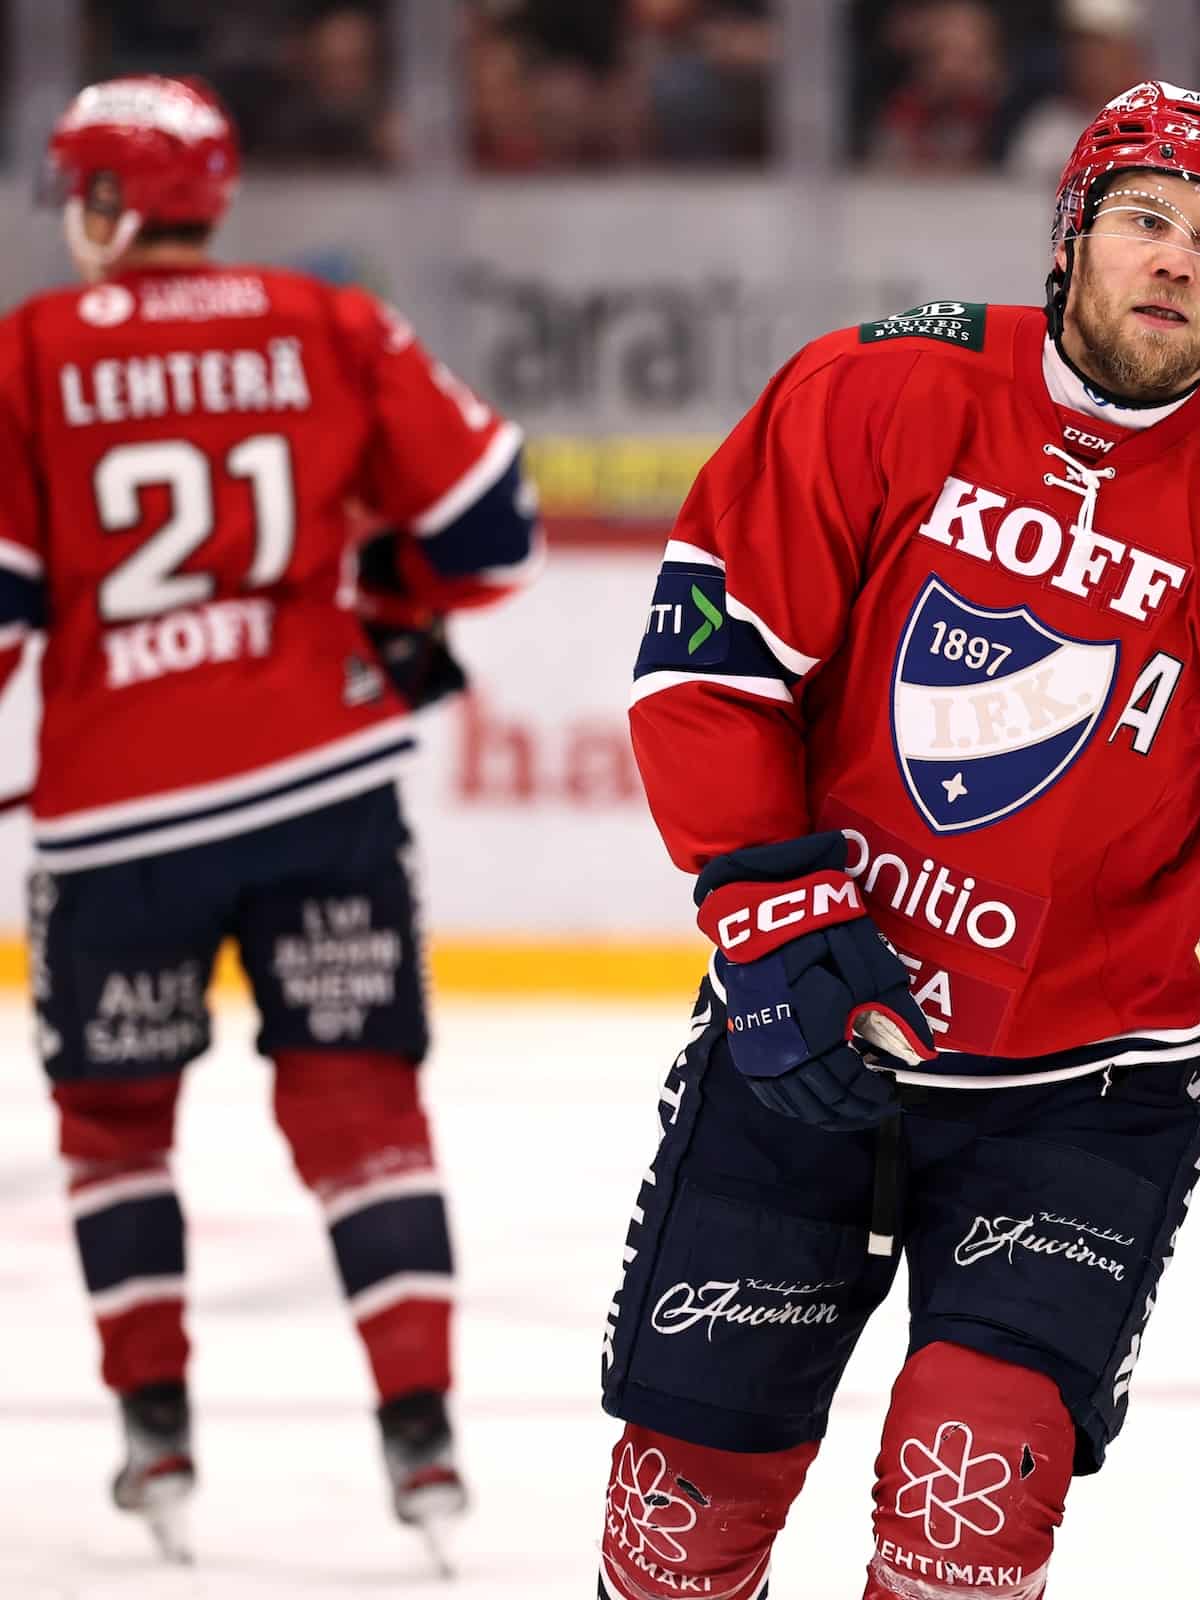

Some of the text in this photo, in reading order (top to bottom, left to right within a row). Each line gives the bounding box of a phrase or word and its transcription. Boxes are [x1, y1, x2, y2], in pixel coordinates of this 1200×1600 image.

[874, 325, 970, 341] BANKERS
[883, 319, 962, 330] UNITED
[1063, 425, 1116, 454] CCM
[96, 434, 295, 621] 21
[919, 476, 1186, 622] KOFF
[929, 620, 1013, 677] 1897
[928, 660, 1093, 749] I.F.K.
[1108, 650, 1185, 756] A
[718, 880, 860, 950] CCM
[734, 1003, 791, 1032] OMEN
[954, 1215, 1125, 1282] Auvinen
[651, 1279, 839, 1343] Auvinen
